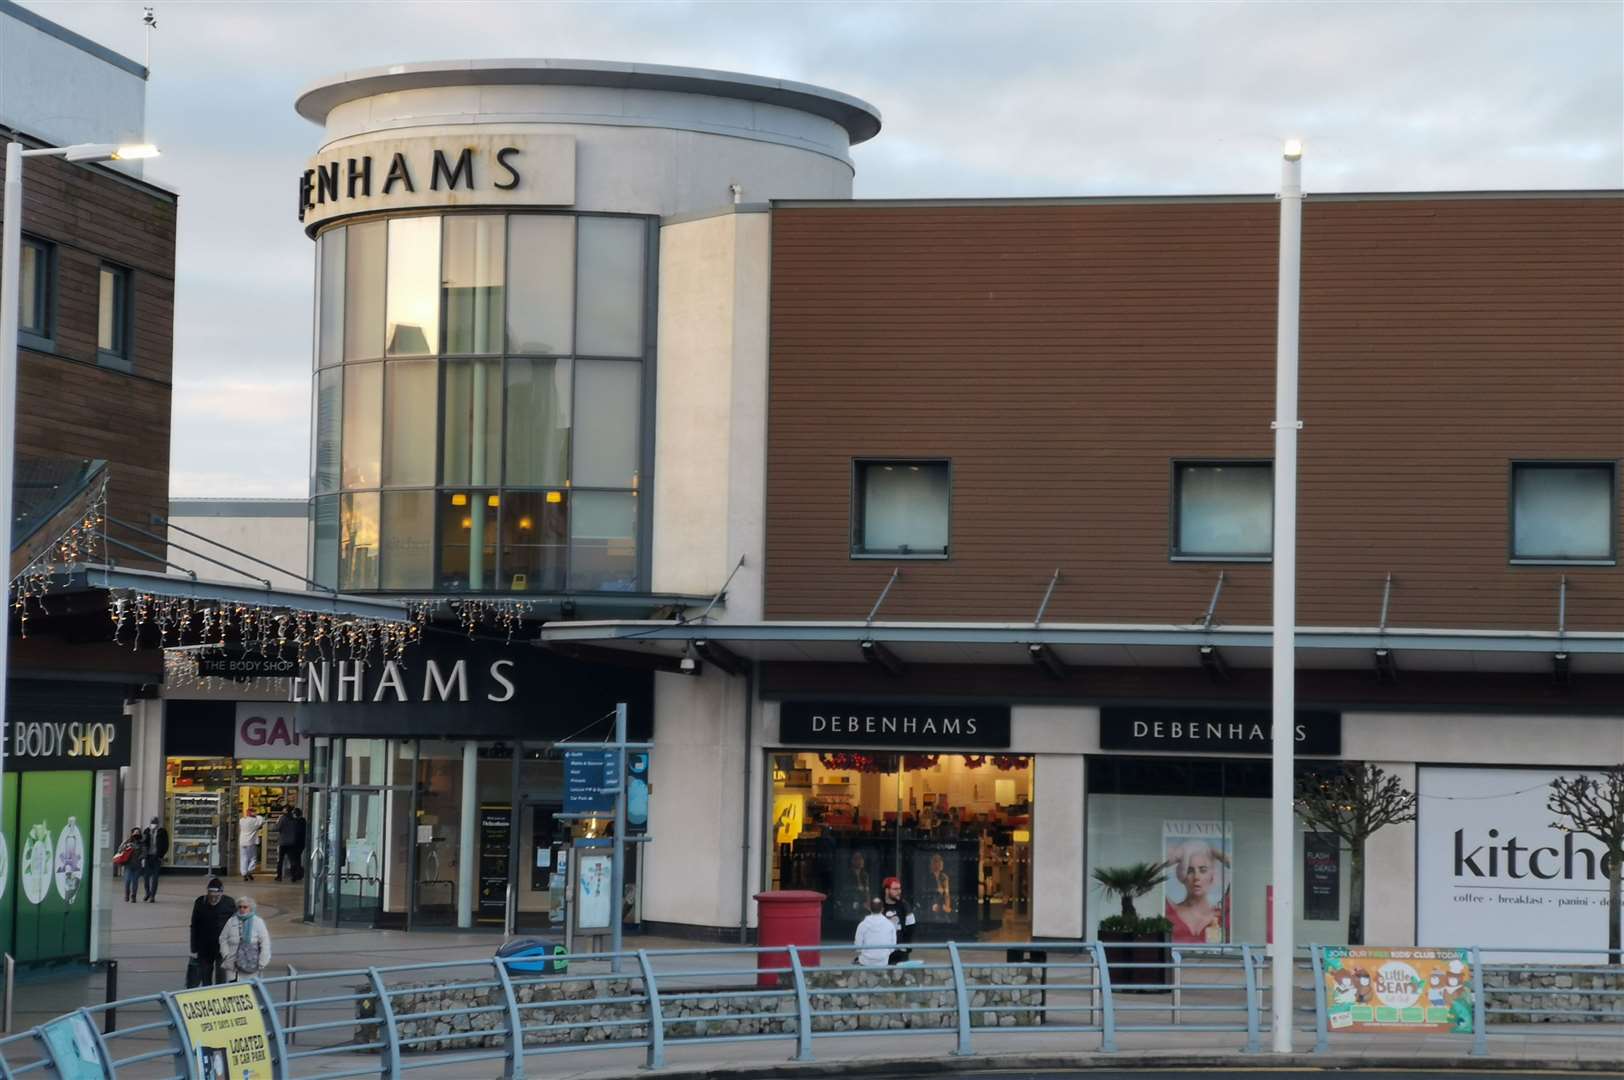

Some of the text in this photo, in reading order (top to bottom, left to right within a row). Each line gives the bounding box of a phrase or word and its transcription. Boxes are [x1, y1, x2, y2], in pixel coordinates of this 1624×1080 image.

[299, 147, 521, 223] ENHAMS
[205, 660, 294, 671] THE BODY SHOP
[287, 660, 515, 702] ENHAMS
[240, 716, 304, 747] GA
[812, 716, 978, 735] DEBENHAMS
[1134, 721, 1307, 741] DEBENHAS
[14, 721, 66, 757] BODY
[67, 721, 115, 757] SHOP
[1453, 893, 1485, 903] coffee
[1498, 894, 1543, 905] breakfast
[1558, 896, 1588, 907] panini
[183, 994, 254, 1019] CASH4CLOTHES
[229, 1034, 264, 1054] LOCATED
